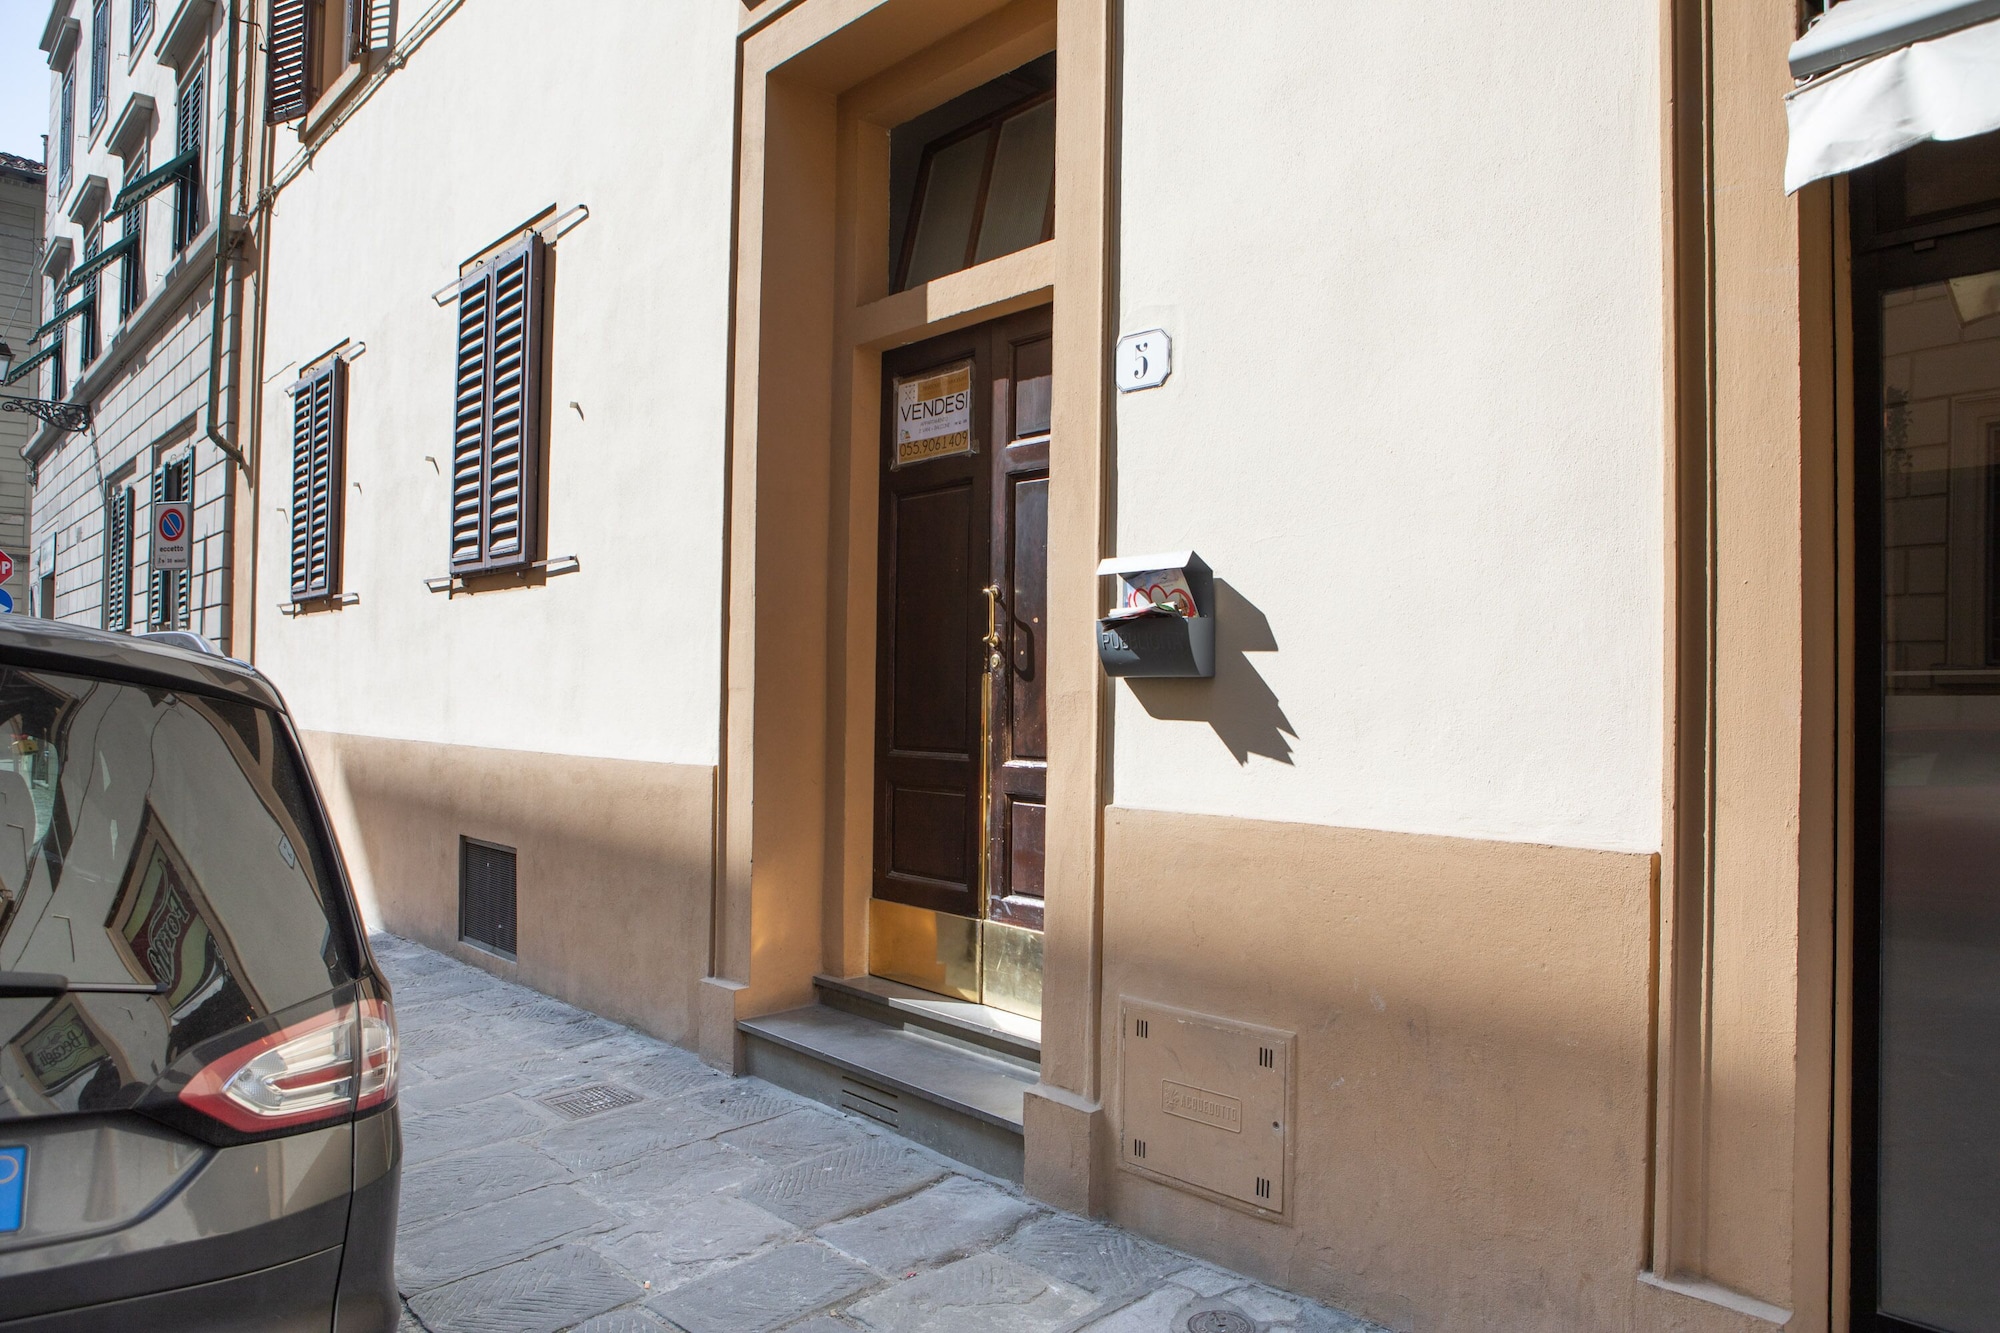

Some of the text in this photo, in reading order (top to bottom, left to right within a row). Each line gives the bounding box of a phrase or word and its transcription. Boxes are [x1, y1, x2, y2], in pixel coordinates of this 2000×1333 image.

[1134, 342, 1148, 379] 5
[901, 391, 968, 422] VENDESI
[1180, 1094, 1237, 1121] ACQUEDOTTO
